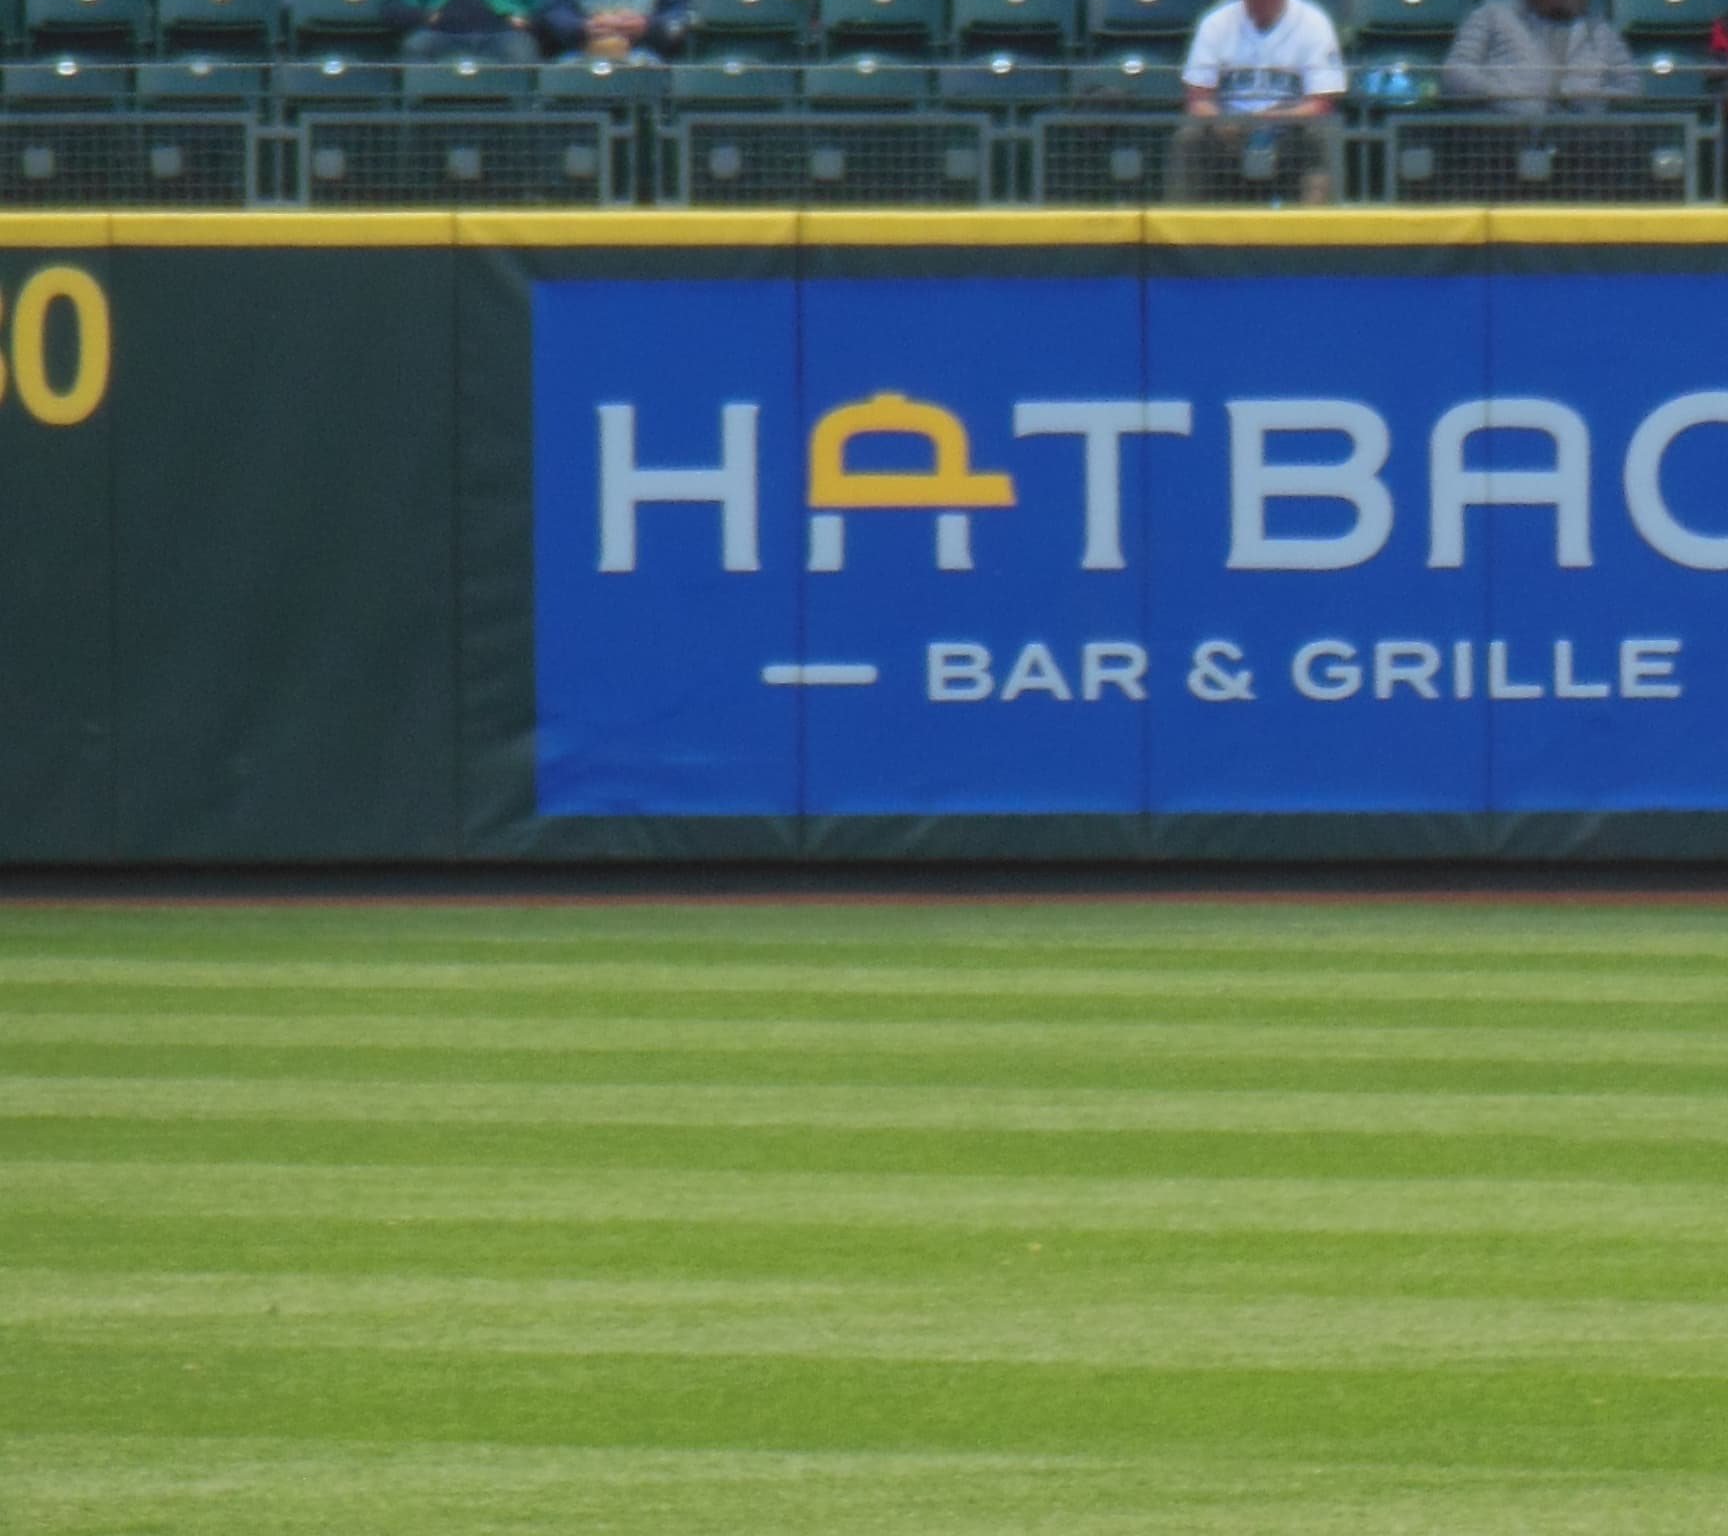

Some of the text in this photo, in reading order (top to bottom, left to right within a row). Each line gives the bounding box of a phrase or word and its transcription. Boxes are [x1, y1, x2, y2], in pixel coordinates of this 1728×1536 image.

[0, 267, 110, 427] 0
[926, 639, 1682, 702] BAR & GRILLE
